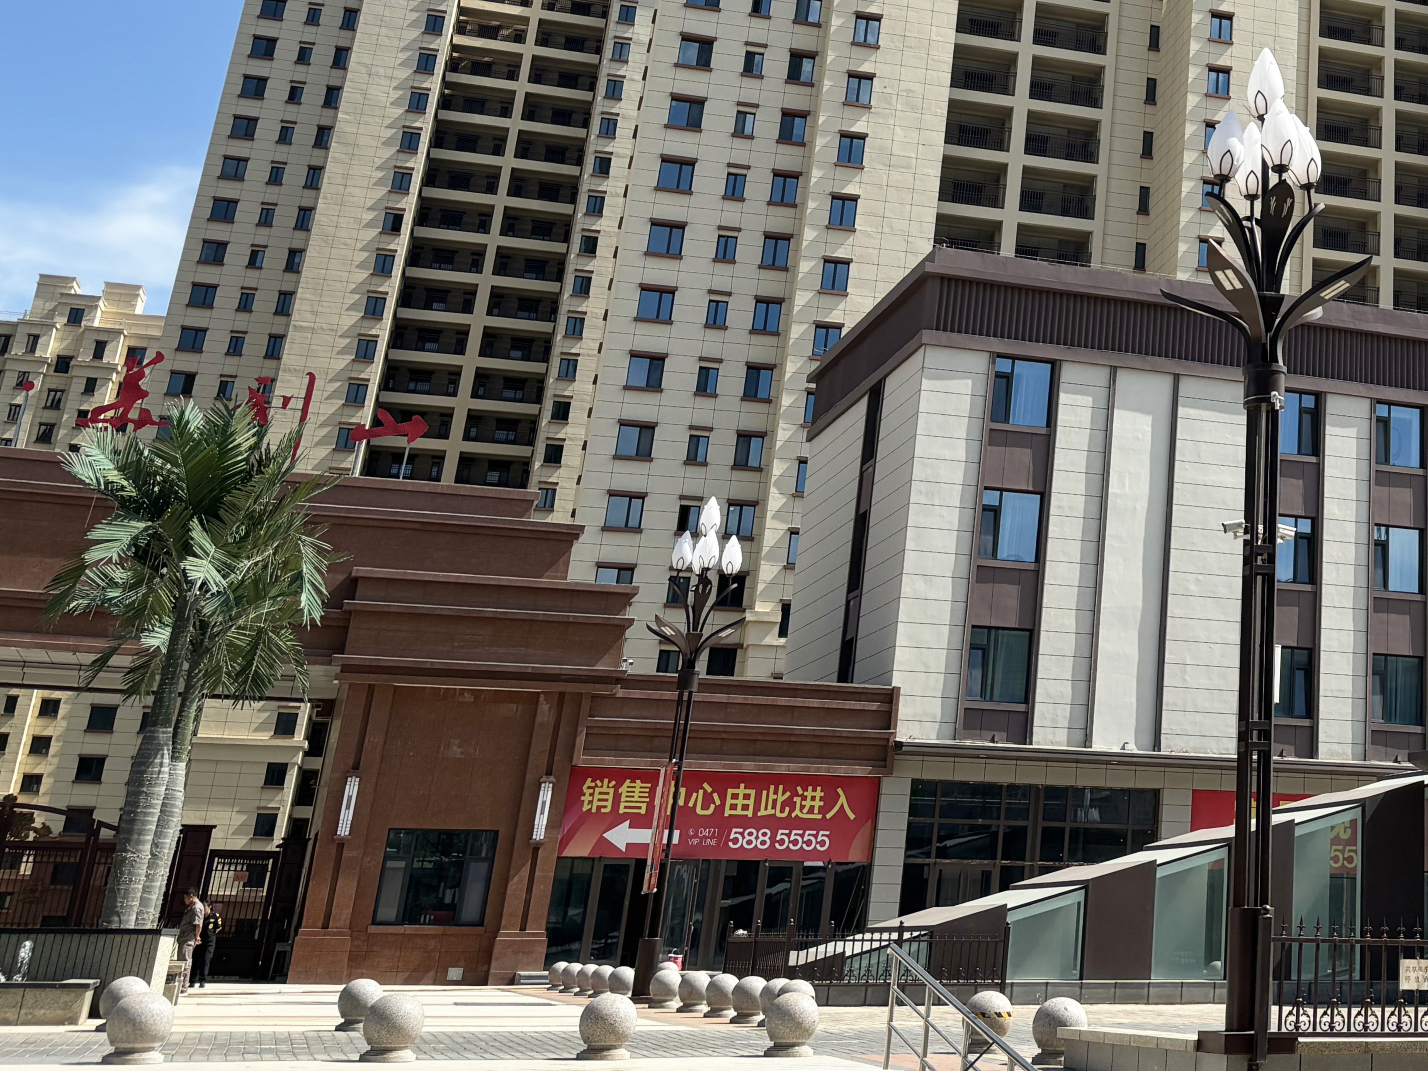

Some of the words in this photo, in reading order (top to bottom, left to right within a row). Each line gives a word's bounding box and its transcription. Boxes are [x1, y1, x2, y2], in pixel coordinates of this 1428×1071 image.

[688, 838, 700, 846] VIP
[702, 838, 718, 846] LINE
[698, 827, 719, 837] 0471
[728, 828, 771, 849] 588
[774, 829, 830, 851] 5555
